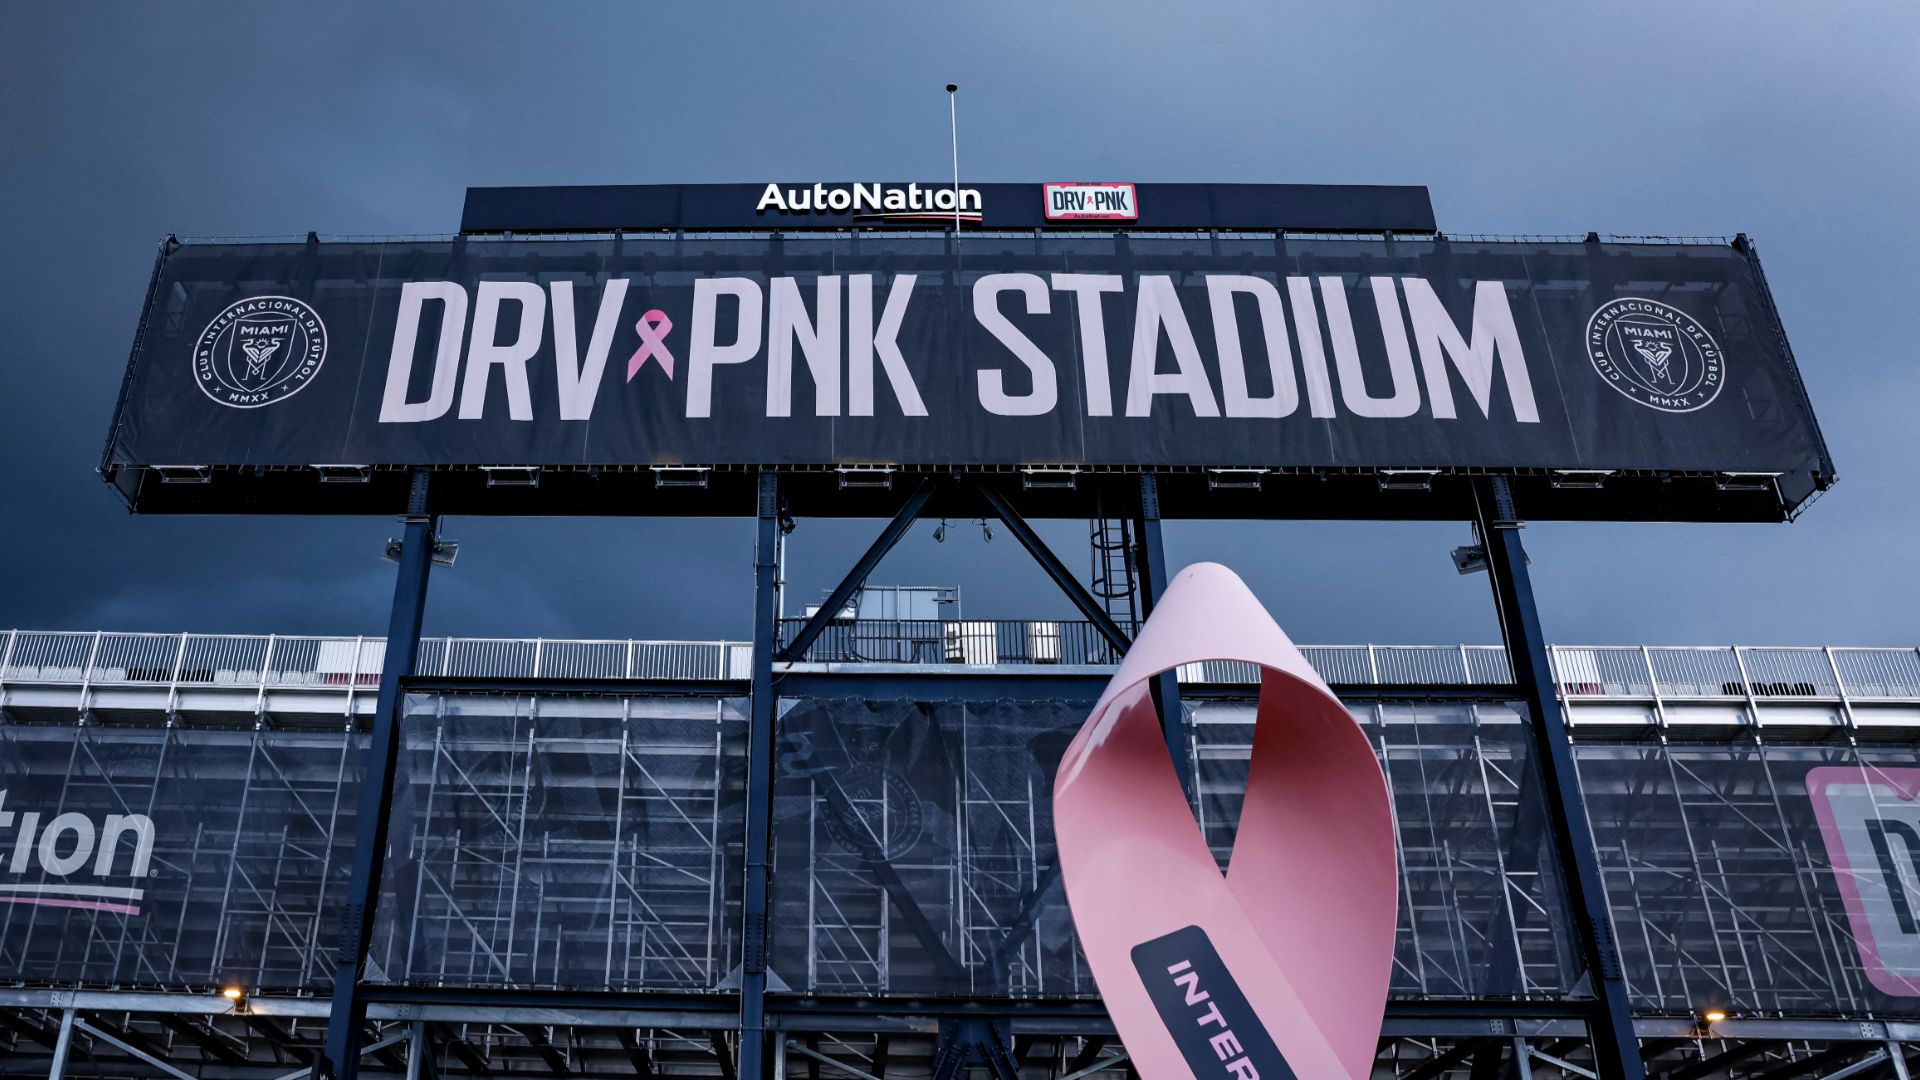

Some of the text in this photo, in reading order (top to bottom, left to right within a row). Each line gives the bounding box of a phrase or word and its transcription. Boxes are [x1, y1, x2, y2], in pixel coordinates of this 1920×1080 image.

[756, 182, 982, 210] AutoNation
[1053, 191, 1128, 210] DRV PNK
[204, 301, 306, 344] INTERNACIONAL
[240, 325, 288, 335] MIAMI
[306, 320, 319, 334] DE
[1592, 302, 1682, 345] INTERNACIONAL
[1624, 327, 1672, 339] MIAMI
[1686, 325, 1703, 340] DE
[378, 272, 1540, 423] DRV PNK STADIUM
[200, 350, 212, 381] CLUB
[1595, 351, 1620, 381] CLUB
[229, 392, 269, 403] MMXX
[1650, 395, 1690, 407] MMXX
